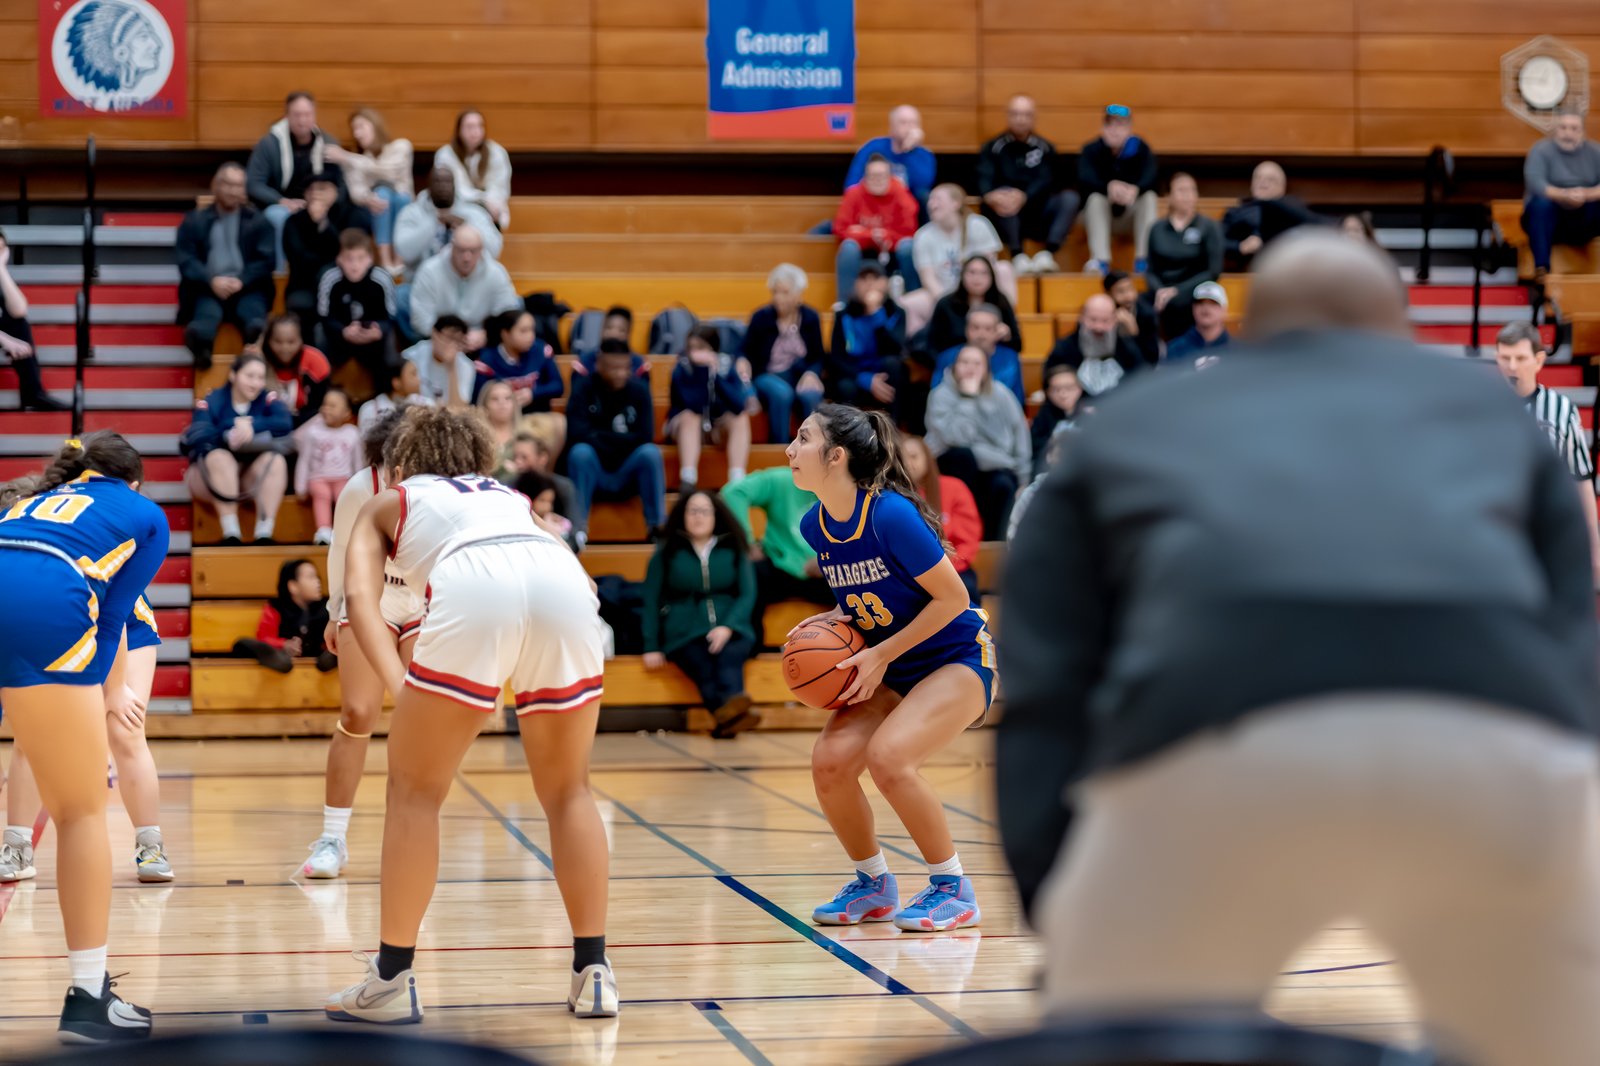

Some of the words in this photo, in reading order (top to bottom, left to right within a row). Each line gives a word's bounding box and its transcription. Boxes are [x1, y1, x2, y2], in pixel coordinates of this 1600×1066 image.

[735, 26, 829, 55] General
[721, 60, 842, 89] Admission
[0, 494, 95, 525] 10
[822, 556, 891, 589] CHARGERS
[845, 591, 894, 631] 33
